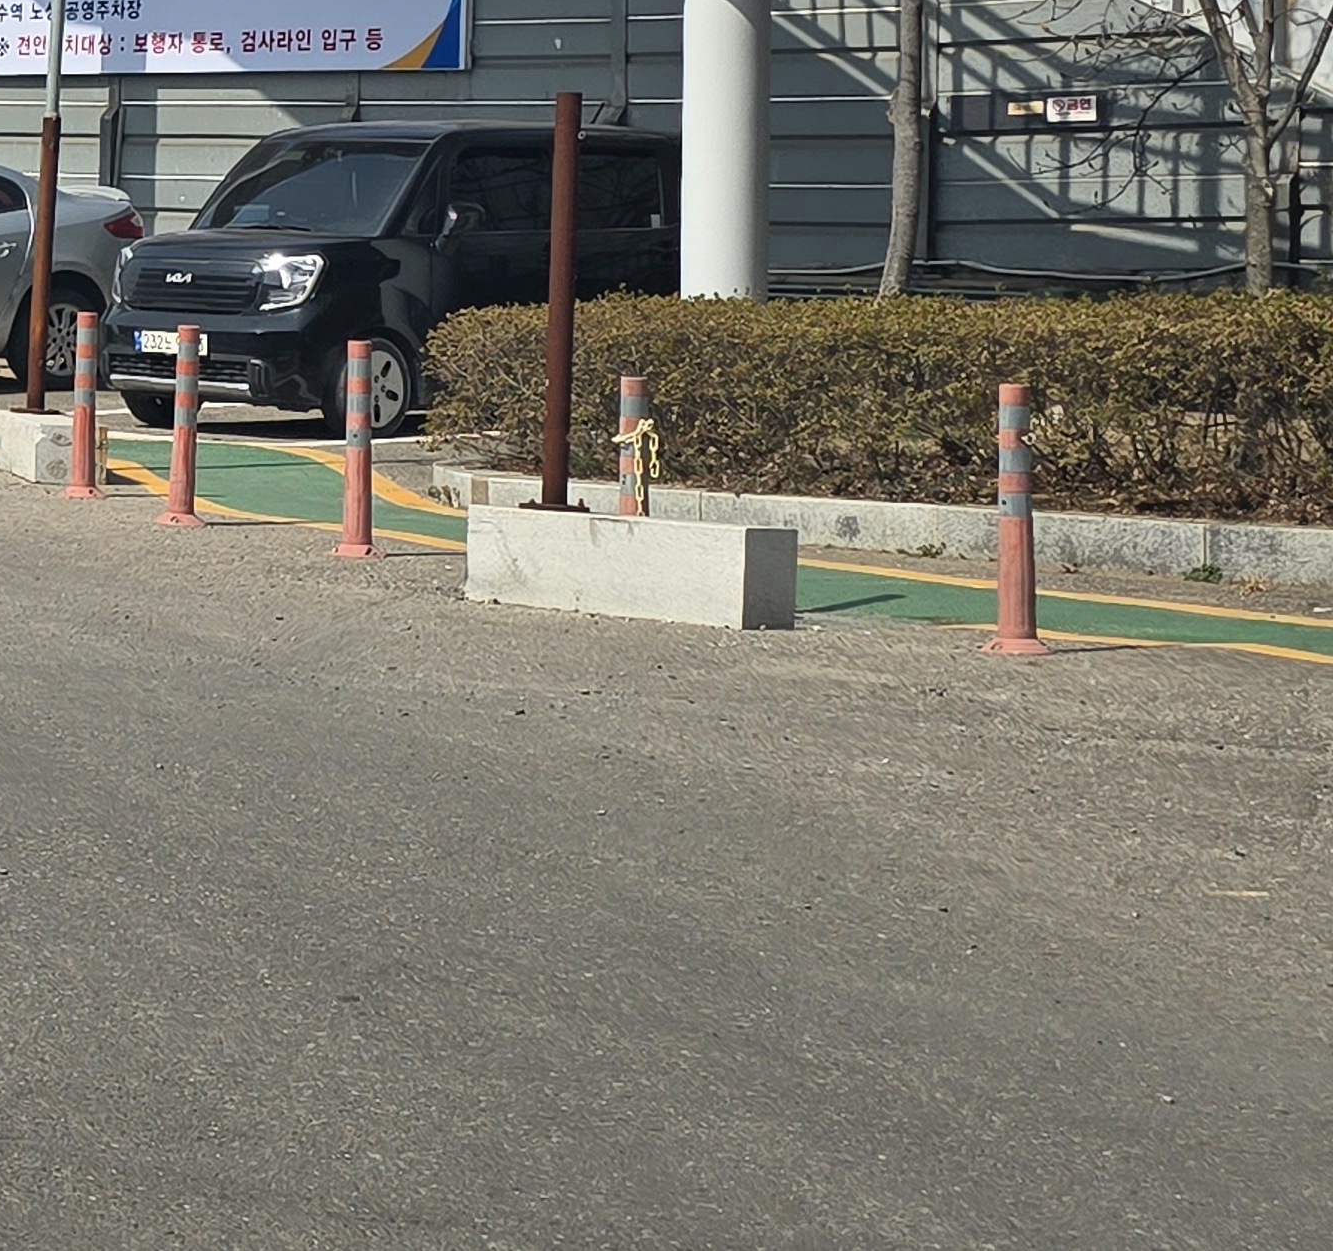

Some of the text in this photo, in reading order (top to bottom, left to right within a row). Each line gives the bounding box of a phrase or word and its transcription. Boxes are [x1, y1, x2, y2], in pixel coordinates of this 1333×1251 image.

[65, 0, 142, 21] 공영주차장
[17, 33, 112, 56] 견인치대상
[132, 31, 183, 56] 보행자
[191, 31, 231, 55] 통로,
[241, 29, 311, 53] 검사라인
[321, 28, 357, 52] 입구
[365, 27, 383, 51] 등
